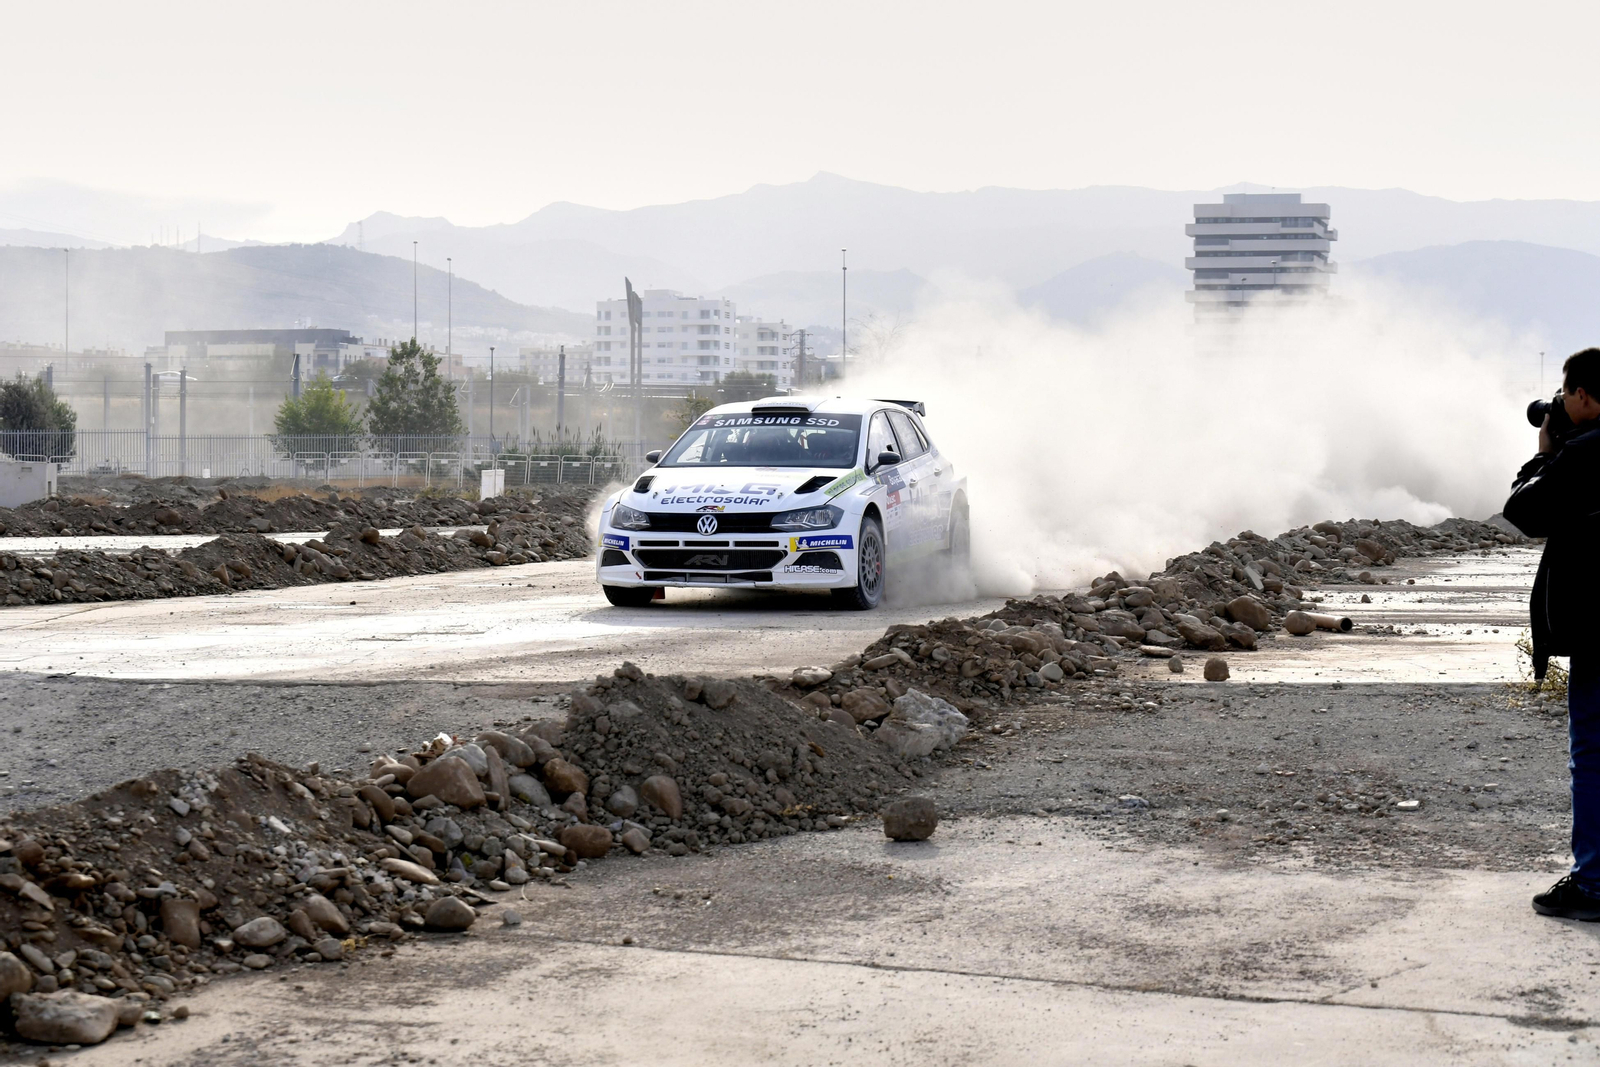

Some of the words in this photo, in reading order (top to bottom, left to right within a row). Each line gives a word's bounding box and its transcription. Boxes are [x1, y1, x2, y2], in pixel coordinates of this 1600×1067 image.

[714, 417, 802, 427] SAMSUNG
[805, 417, 840, 427] SSD
[809, 539, 847, 547] MICHELIN
